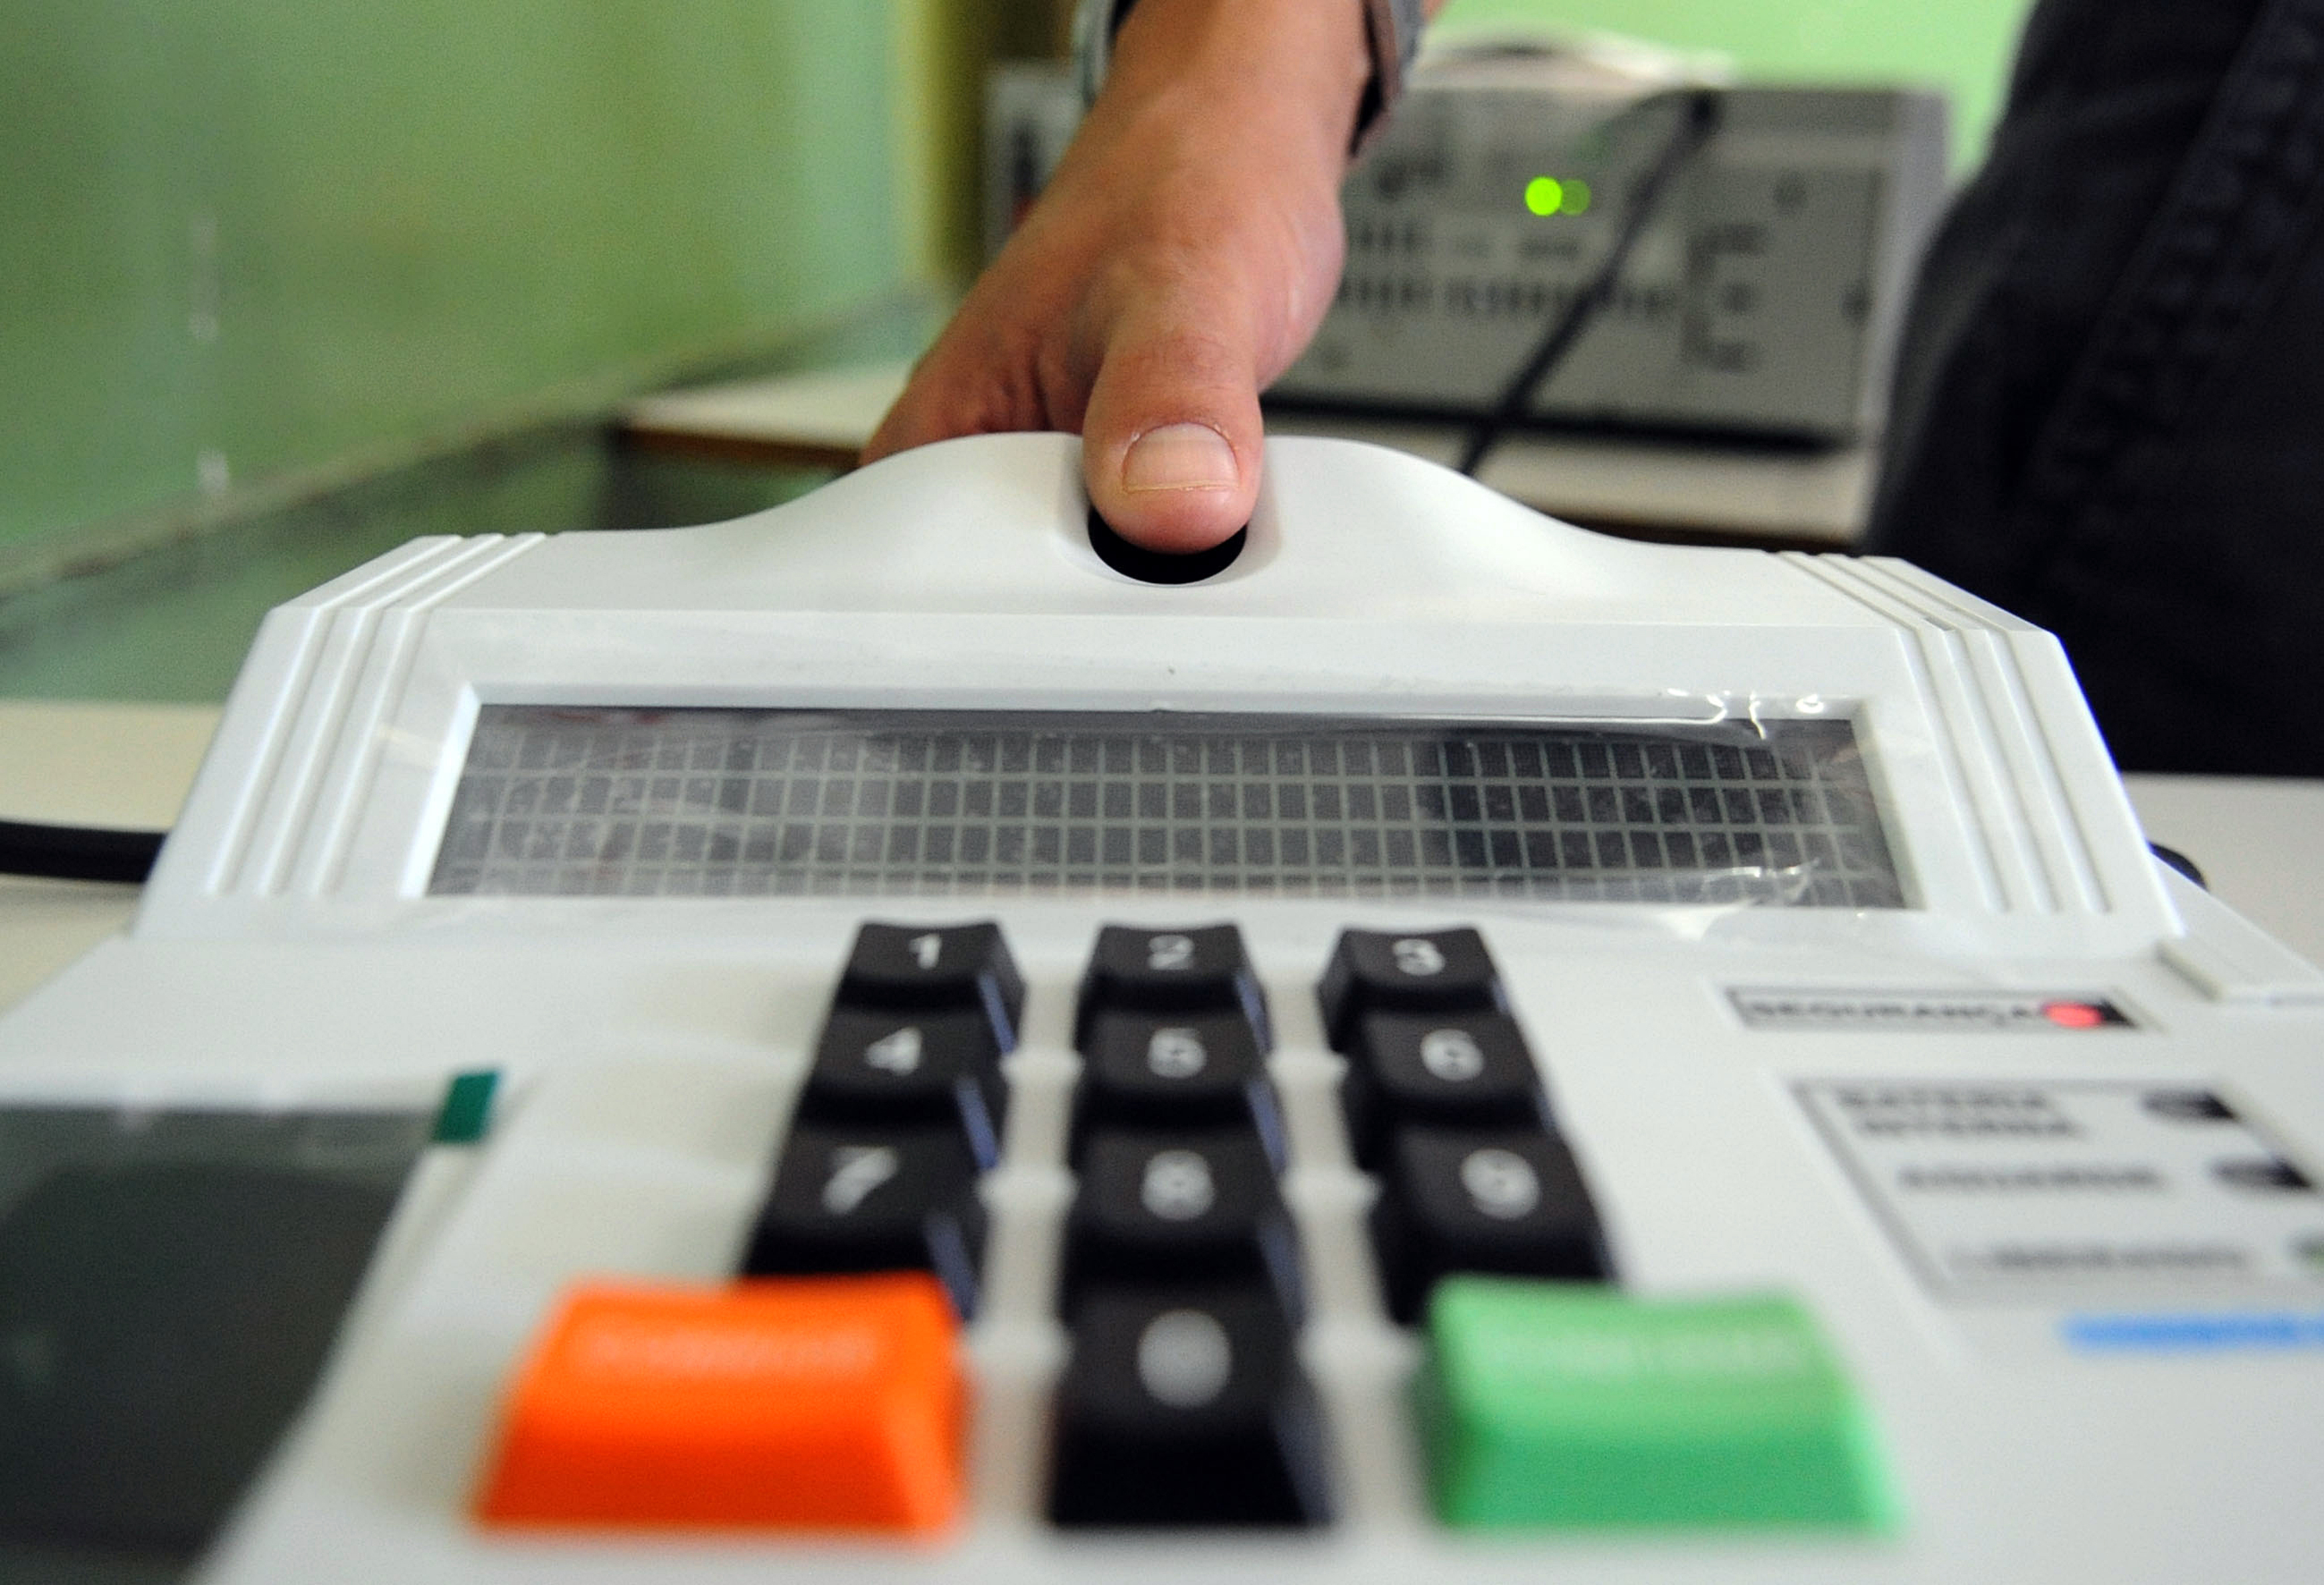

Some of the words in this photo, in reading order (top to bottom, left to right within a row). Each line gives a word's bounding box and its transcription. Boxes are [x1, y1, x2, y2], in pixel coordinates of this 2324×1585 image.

[909, 932, 943, 970] 1
[1147, 933, 1196, 972] 2
[1390, 936, 1447, 978] 3
[865, 1027, 923, 1075] 4
[1146, 1027, 1207, 1079] 5
[1418, 1027, 1485, 1082] 6
[824, 1146, 896, 1212] 7
[1141, 1150, 1214, 1219] 8
[1459, 1148, 1541, 1219] 9
